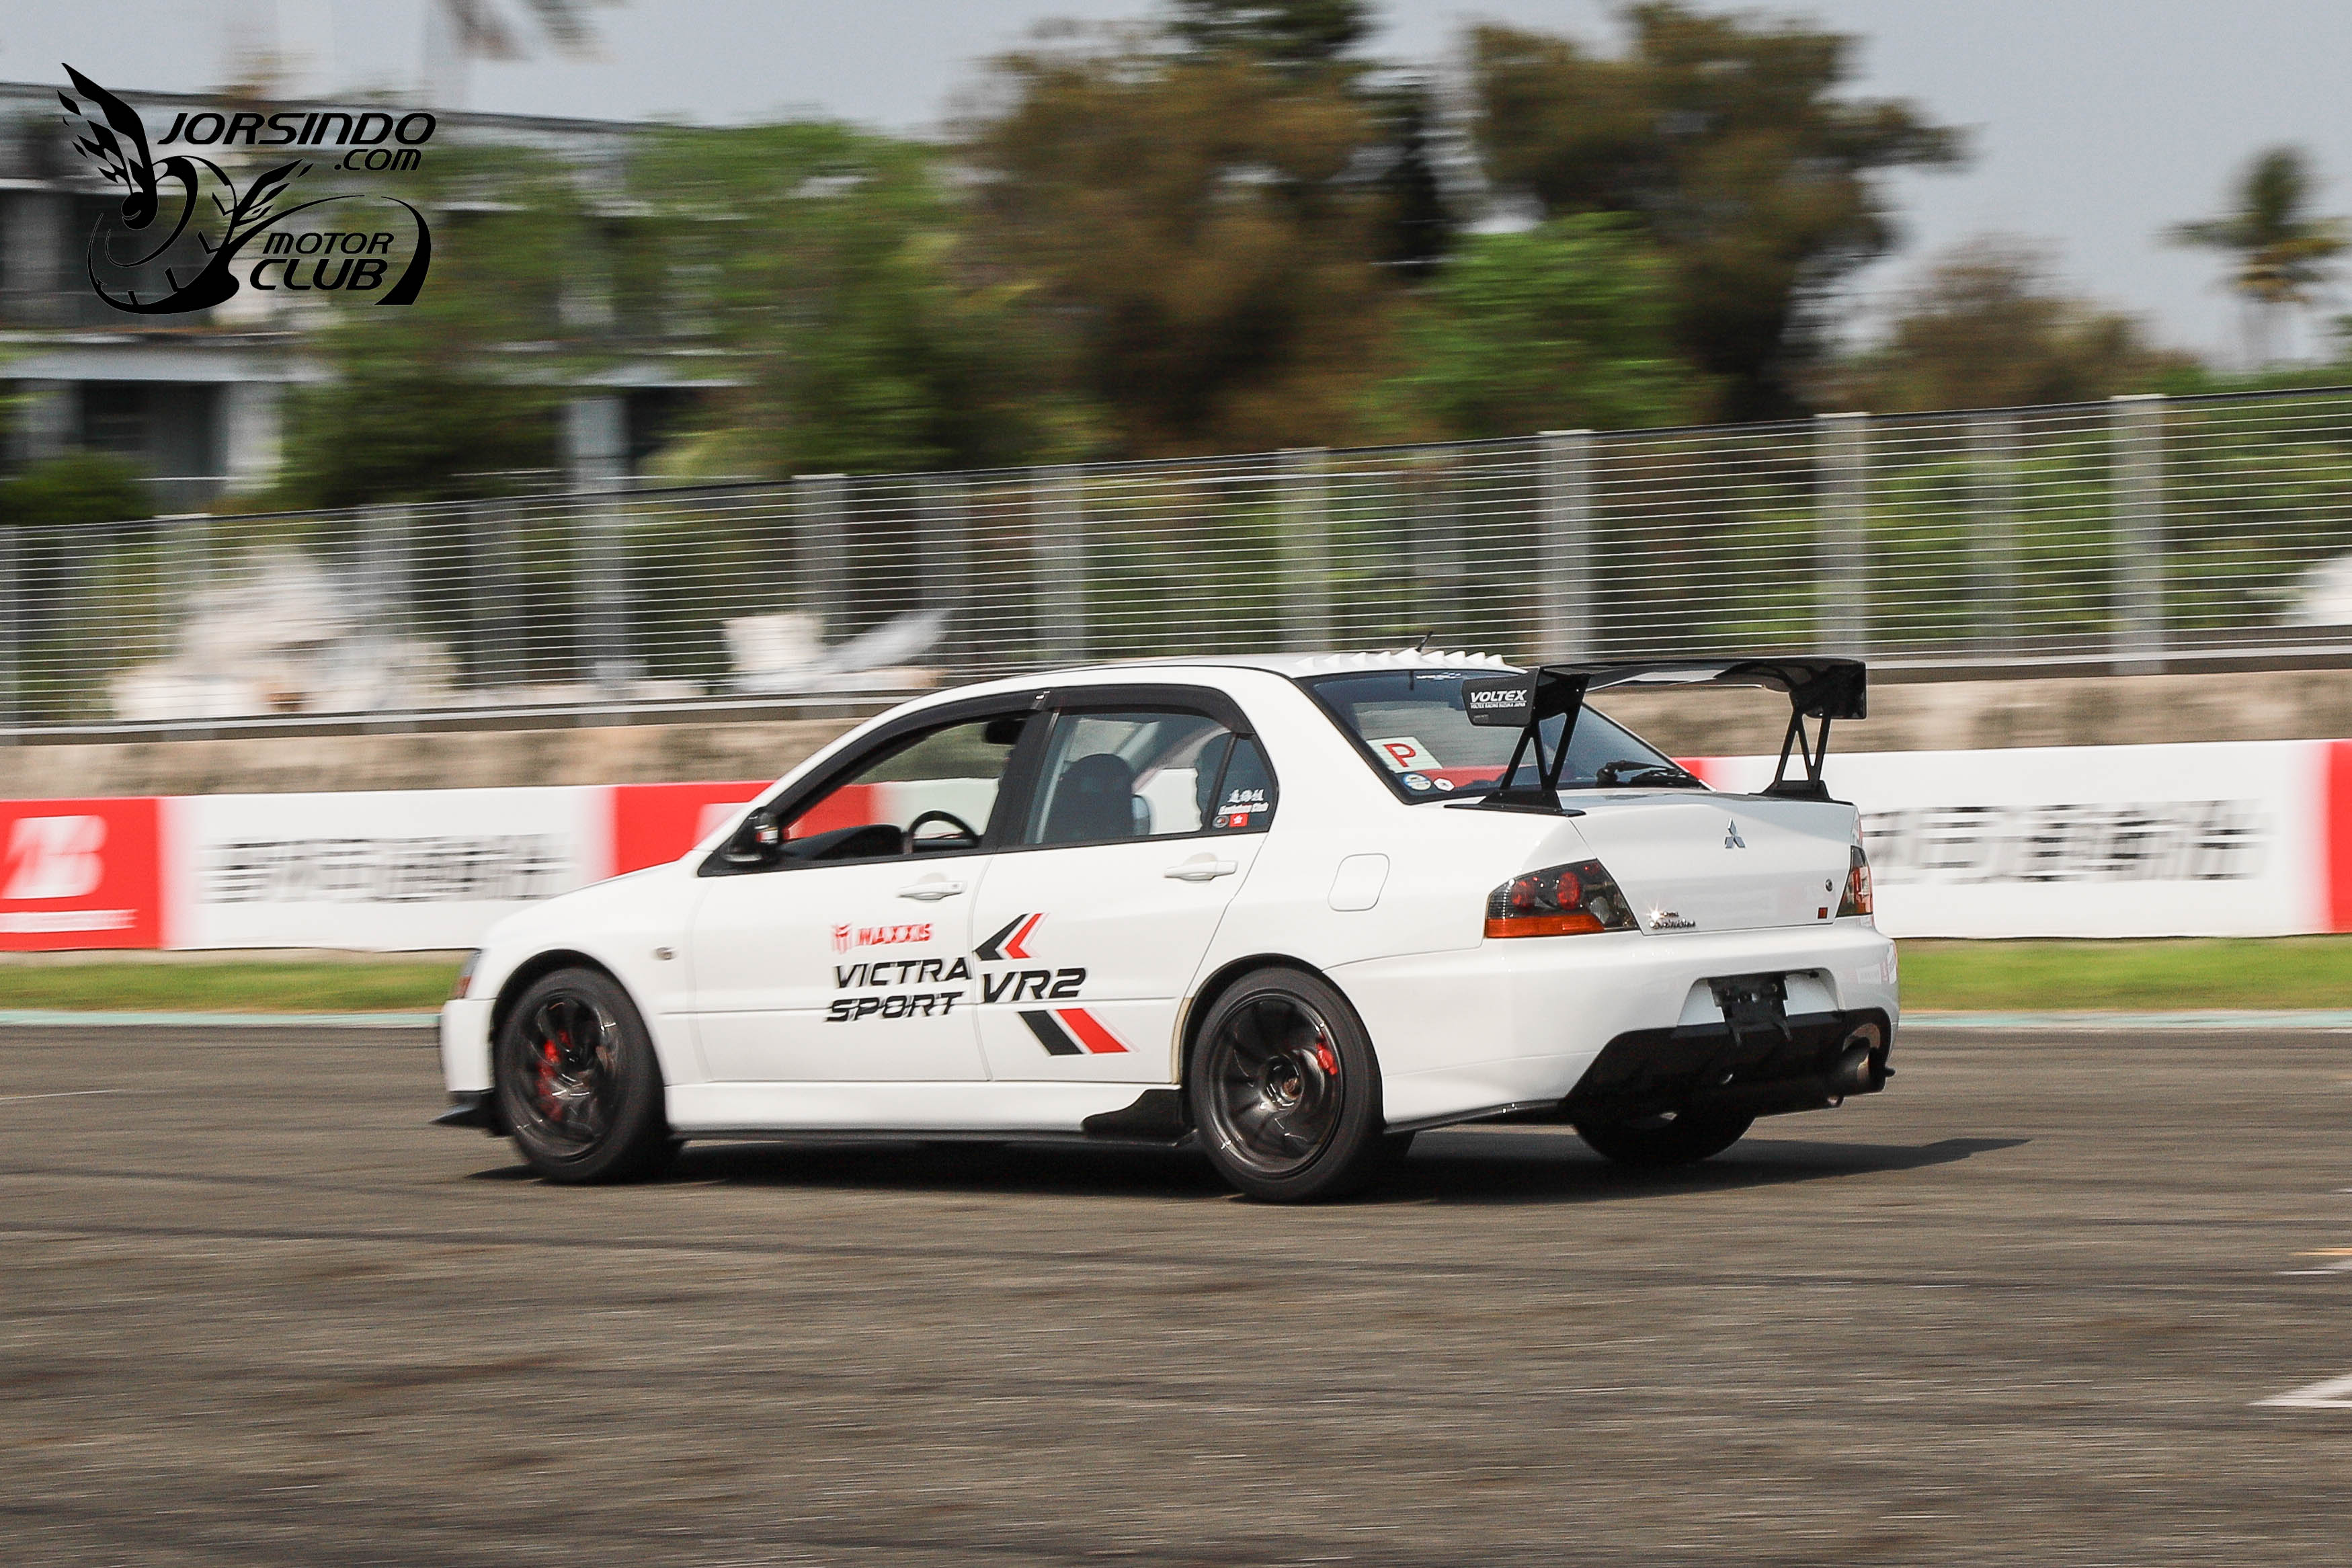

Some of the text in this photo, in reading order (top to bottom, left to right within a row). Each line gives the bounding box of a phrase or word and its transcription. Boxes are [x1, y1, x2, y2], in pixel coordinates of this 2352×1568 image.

[1471, 690, 1527, 702] VOLTEX
[1383, 743, 1416, 768] P
[856, 923, 934, 946] MAXXIS
[834, 957, 973, 989] VICTRA
[982, 968, 1087, 1003] VR2
[823, 992, 966, 1022] SPORT
